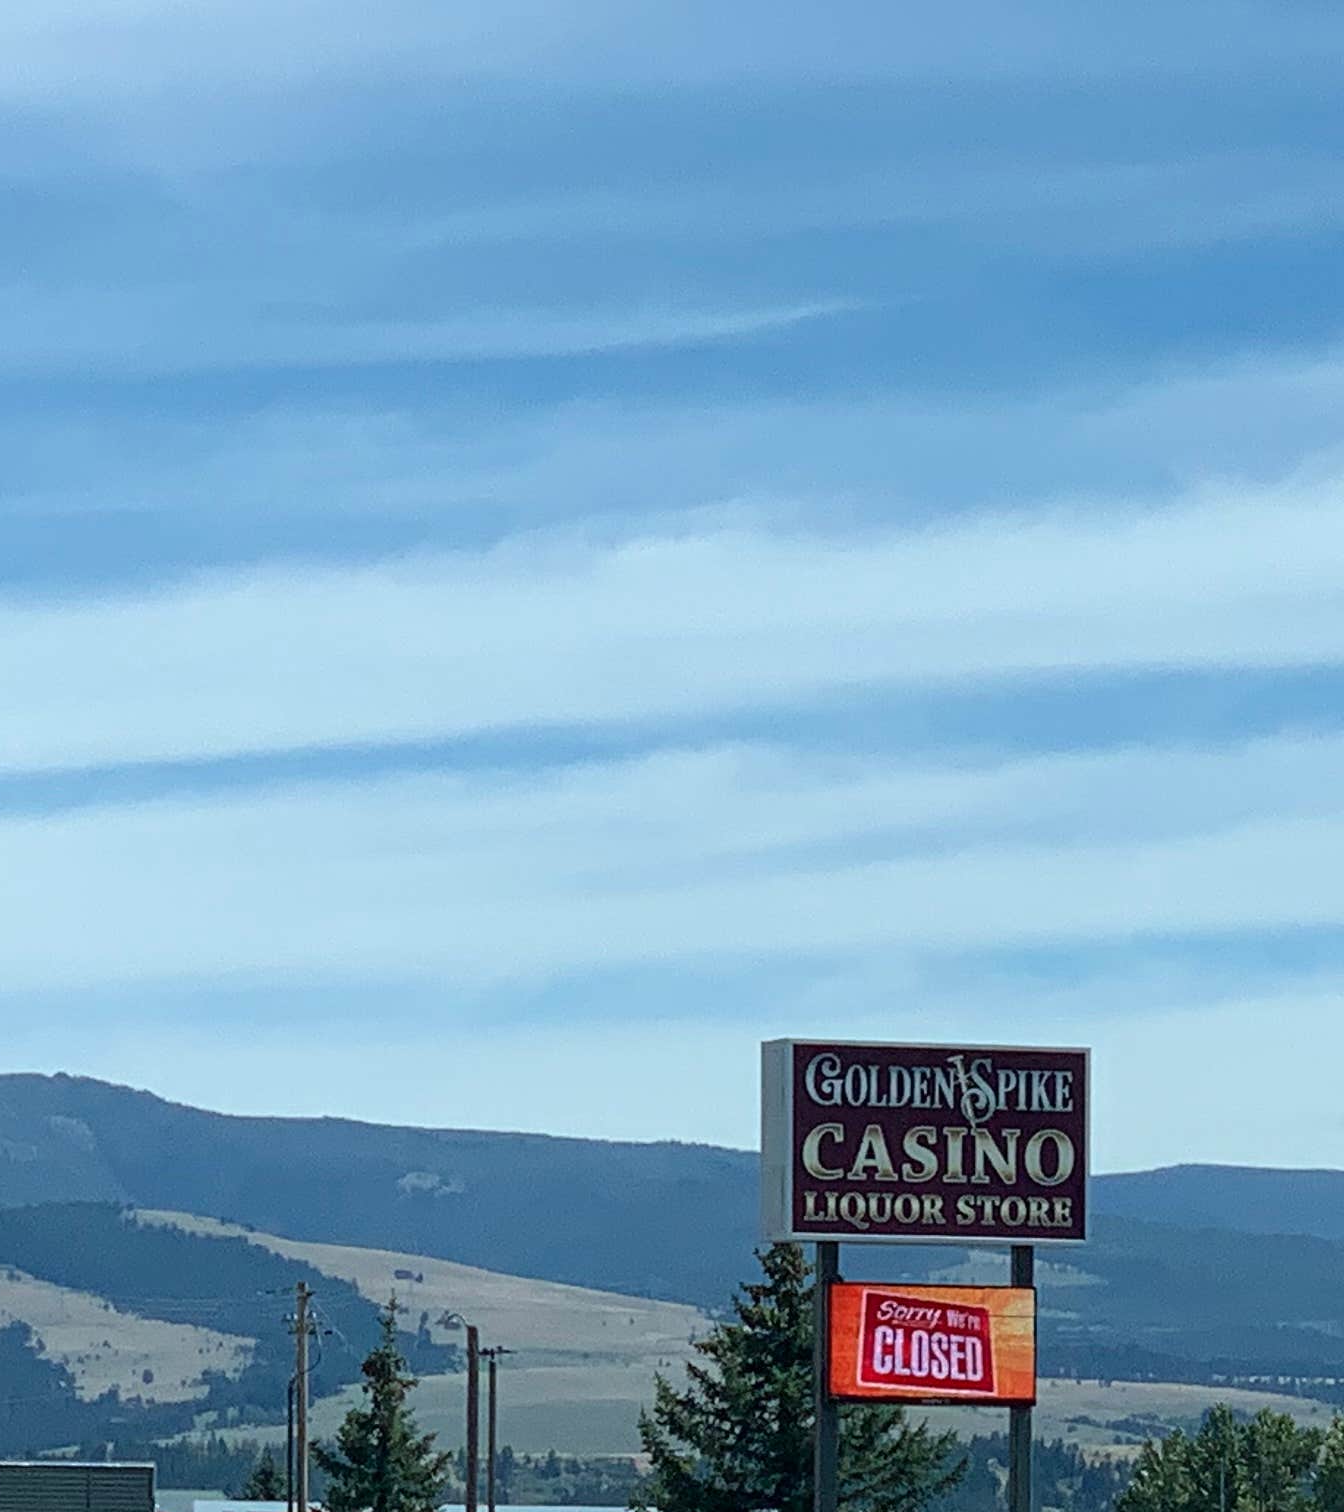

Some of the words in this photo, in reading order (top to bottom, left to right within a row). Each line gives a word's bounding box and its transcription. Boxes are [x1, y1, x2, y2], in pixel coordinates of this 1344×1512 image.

[806, 1052, 954, 1109] GOLDEN
[961, 1058, 1074, 1123] SPIKE
[802, 1122, 1075, 1187] CASINO
[804, 1191, 947, 1229] LIQUOR
[956, 1194, 1074, 1228] STORE
[877, 1300, 942, 1329] Sorry
[872, 1325, 984, 1381] CLOSED
